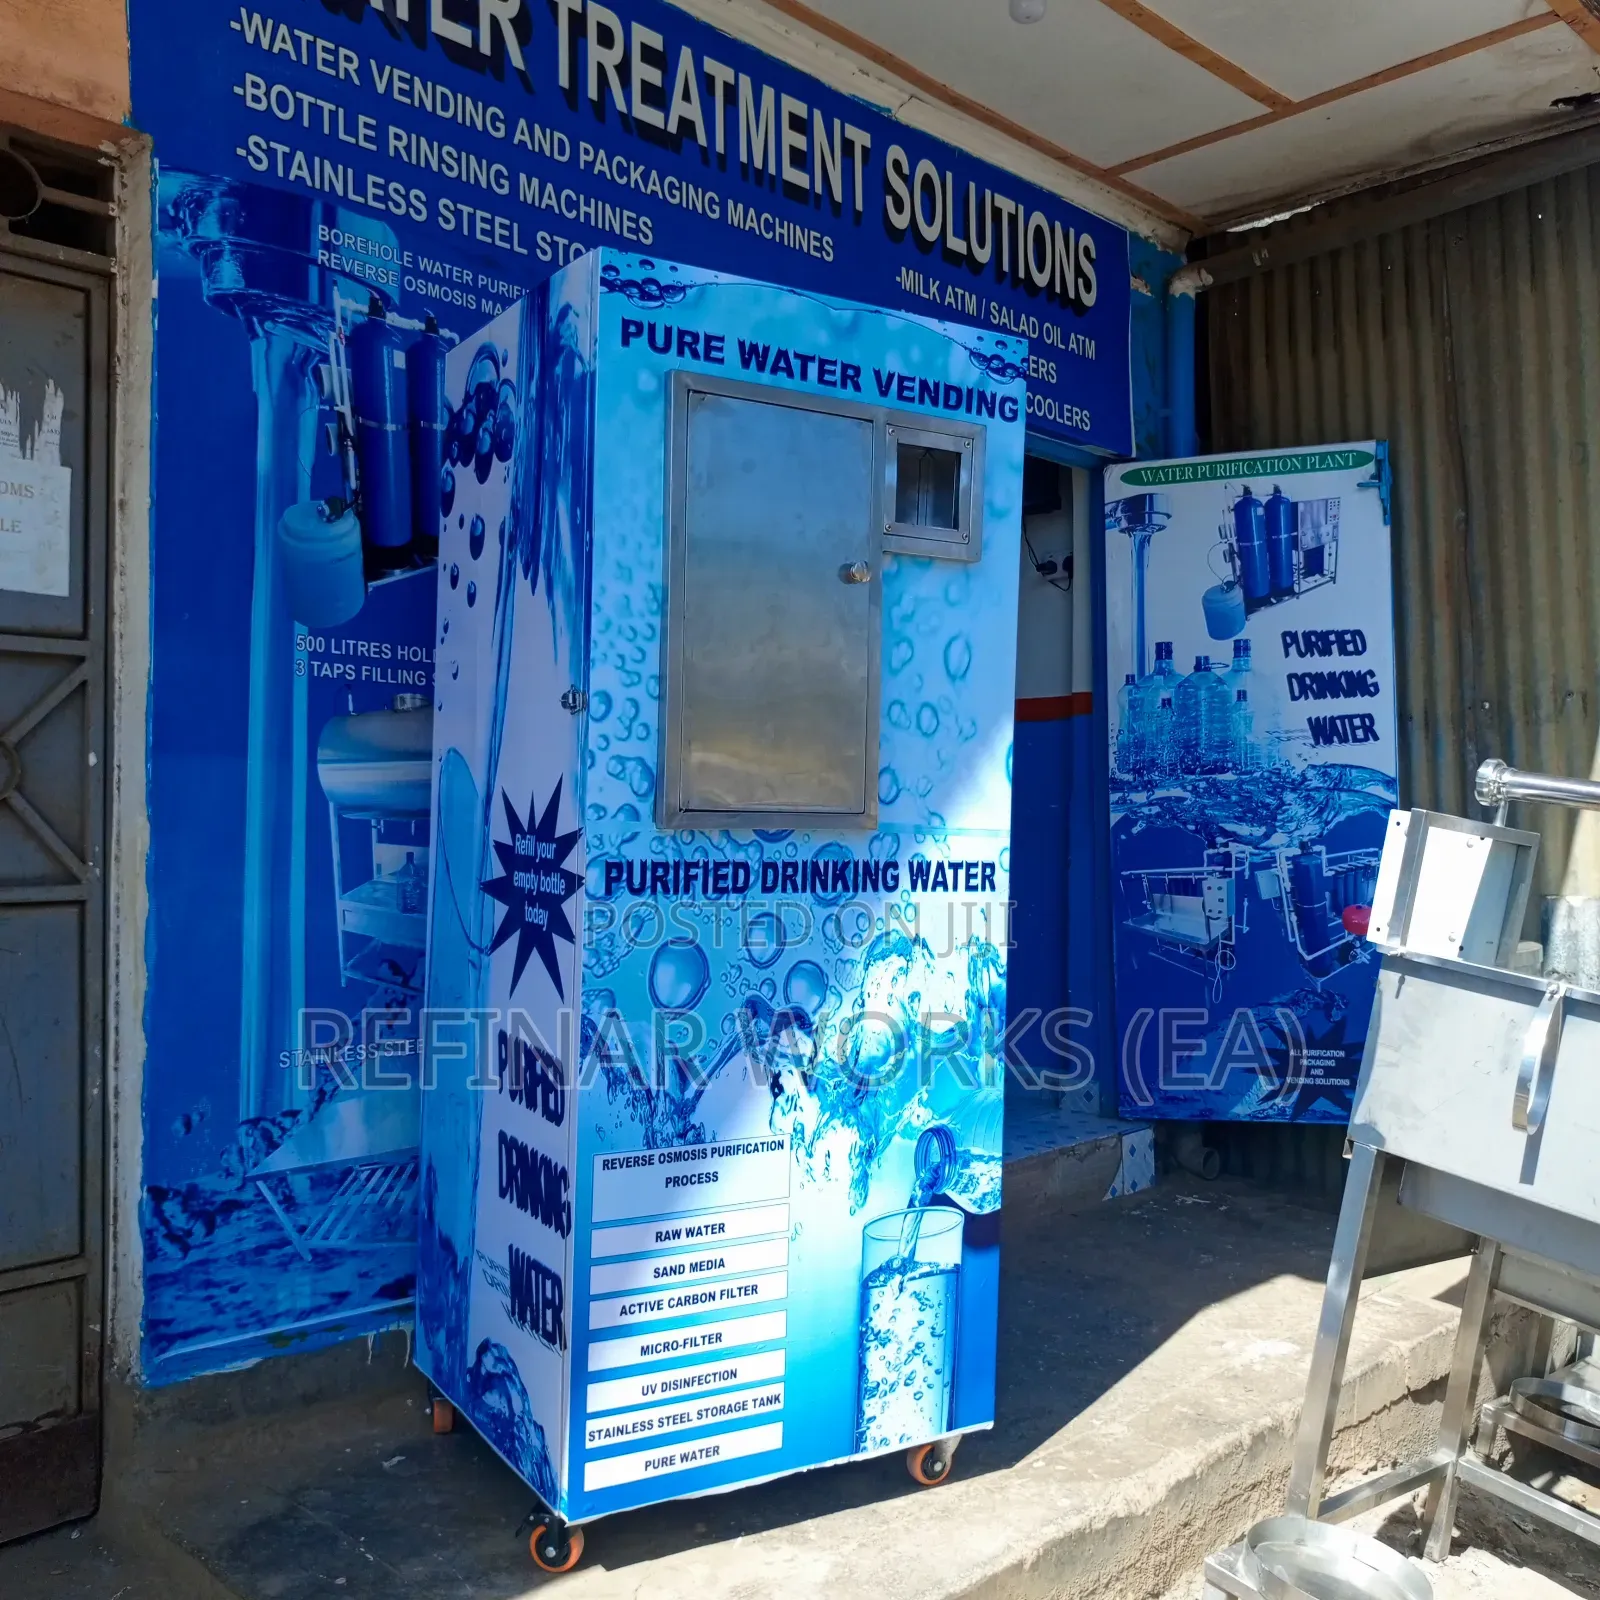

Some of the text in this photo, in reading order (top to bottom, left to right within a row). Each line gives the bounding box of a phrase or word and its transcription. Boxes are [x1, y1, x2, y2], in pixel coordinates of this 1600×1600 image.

[369, 58, 506, 139] VENDING
[513, 117, 571, 164] AND
[579, 141, 720, 219] PACKAGING
[727, 199, 834, 262] MACHINES
[544, 0, 1097, 308] TREATMENT SOLUTIONS
[388, 125, 510, 195] RINSING
[519, 172, 653, 246] MACHINES
[438, 197, 528, 256] STEEL
[318, 225, 413, 268] BOREHOLE
[418, 256, 473, 287] WATER
[318, 249, 399, 288] REVERSE
[404, 276, 476, 310] OSMOSIS
[944, 285, 977, 317] ATM
[981, 298, 986, 319] /
[989, 302, 1039, 339] SALAD
[1043, 323, 1066, 349] OIL
[1068, 337, 1096, 361] ATM
[621, 316, 1019, 423] PURE WATER VENDING
[1026, 355, 1057, 384] ERS
[1026, 391, 1091, 431] COOLERS
[1141, 452, 1356, 484] WATER PURIFICATION PLANT
[295, 635, 326, 653] 500
[331, 638, 392, 660] LITRES
[1281, 629, 1367, 659] PURIFIED
[295, 660, 307, 677] 3
[310, 661, 356, 681] TAPS
[361, 666, 427, 686] FILLING
[1286, 669, 1380, 701] DRINKING
[1306, 713, 1380, 746] WATER
[515, 833, 557, 862] Refill your
[513, 869, 566, 896] empty bottle
[604, 859, 996, 896] PURIFIED DRINKING WATER
[525, 901, 548, 931] today
[279, 1043, 378, 1068] STAINLESS
[1300, 1059, 1336, 1067] PACKAGING
[1303, 1049, 1345, 1058] PURIFICATION
[498, 1029, 565, 1127] PURIFIED
[1286, 1076, 1350, 1086] VENDING SOLUTIONS
[1310, 1068, 1324, 1076] AND
[602, 1139, 785, 1171] REVERSE OSMOSIS PURIFICATION
[498, 1129, 571, 1239] DRINKING
[665, 1171, 719, 1189] PROCESS
[655, 1222, 726, 1243] RAW WATER
[653, 1257, 725, 1279] SAND MEDIA
[508, 1243, 567, 1351] WATER
[619, 1284, 759, 1317] ACTIVE CARBON FILTER
[640, 1332, 723, 1357] MICRO-FILTER
[641, 1368, 738, 1396] UV DISINFECTION
[588, 1393, 782, 1442] STAINLESS STEEL STORAGE TANK
[644, 1445, 720, 1472] PURE WATER
